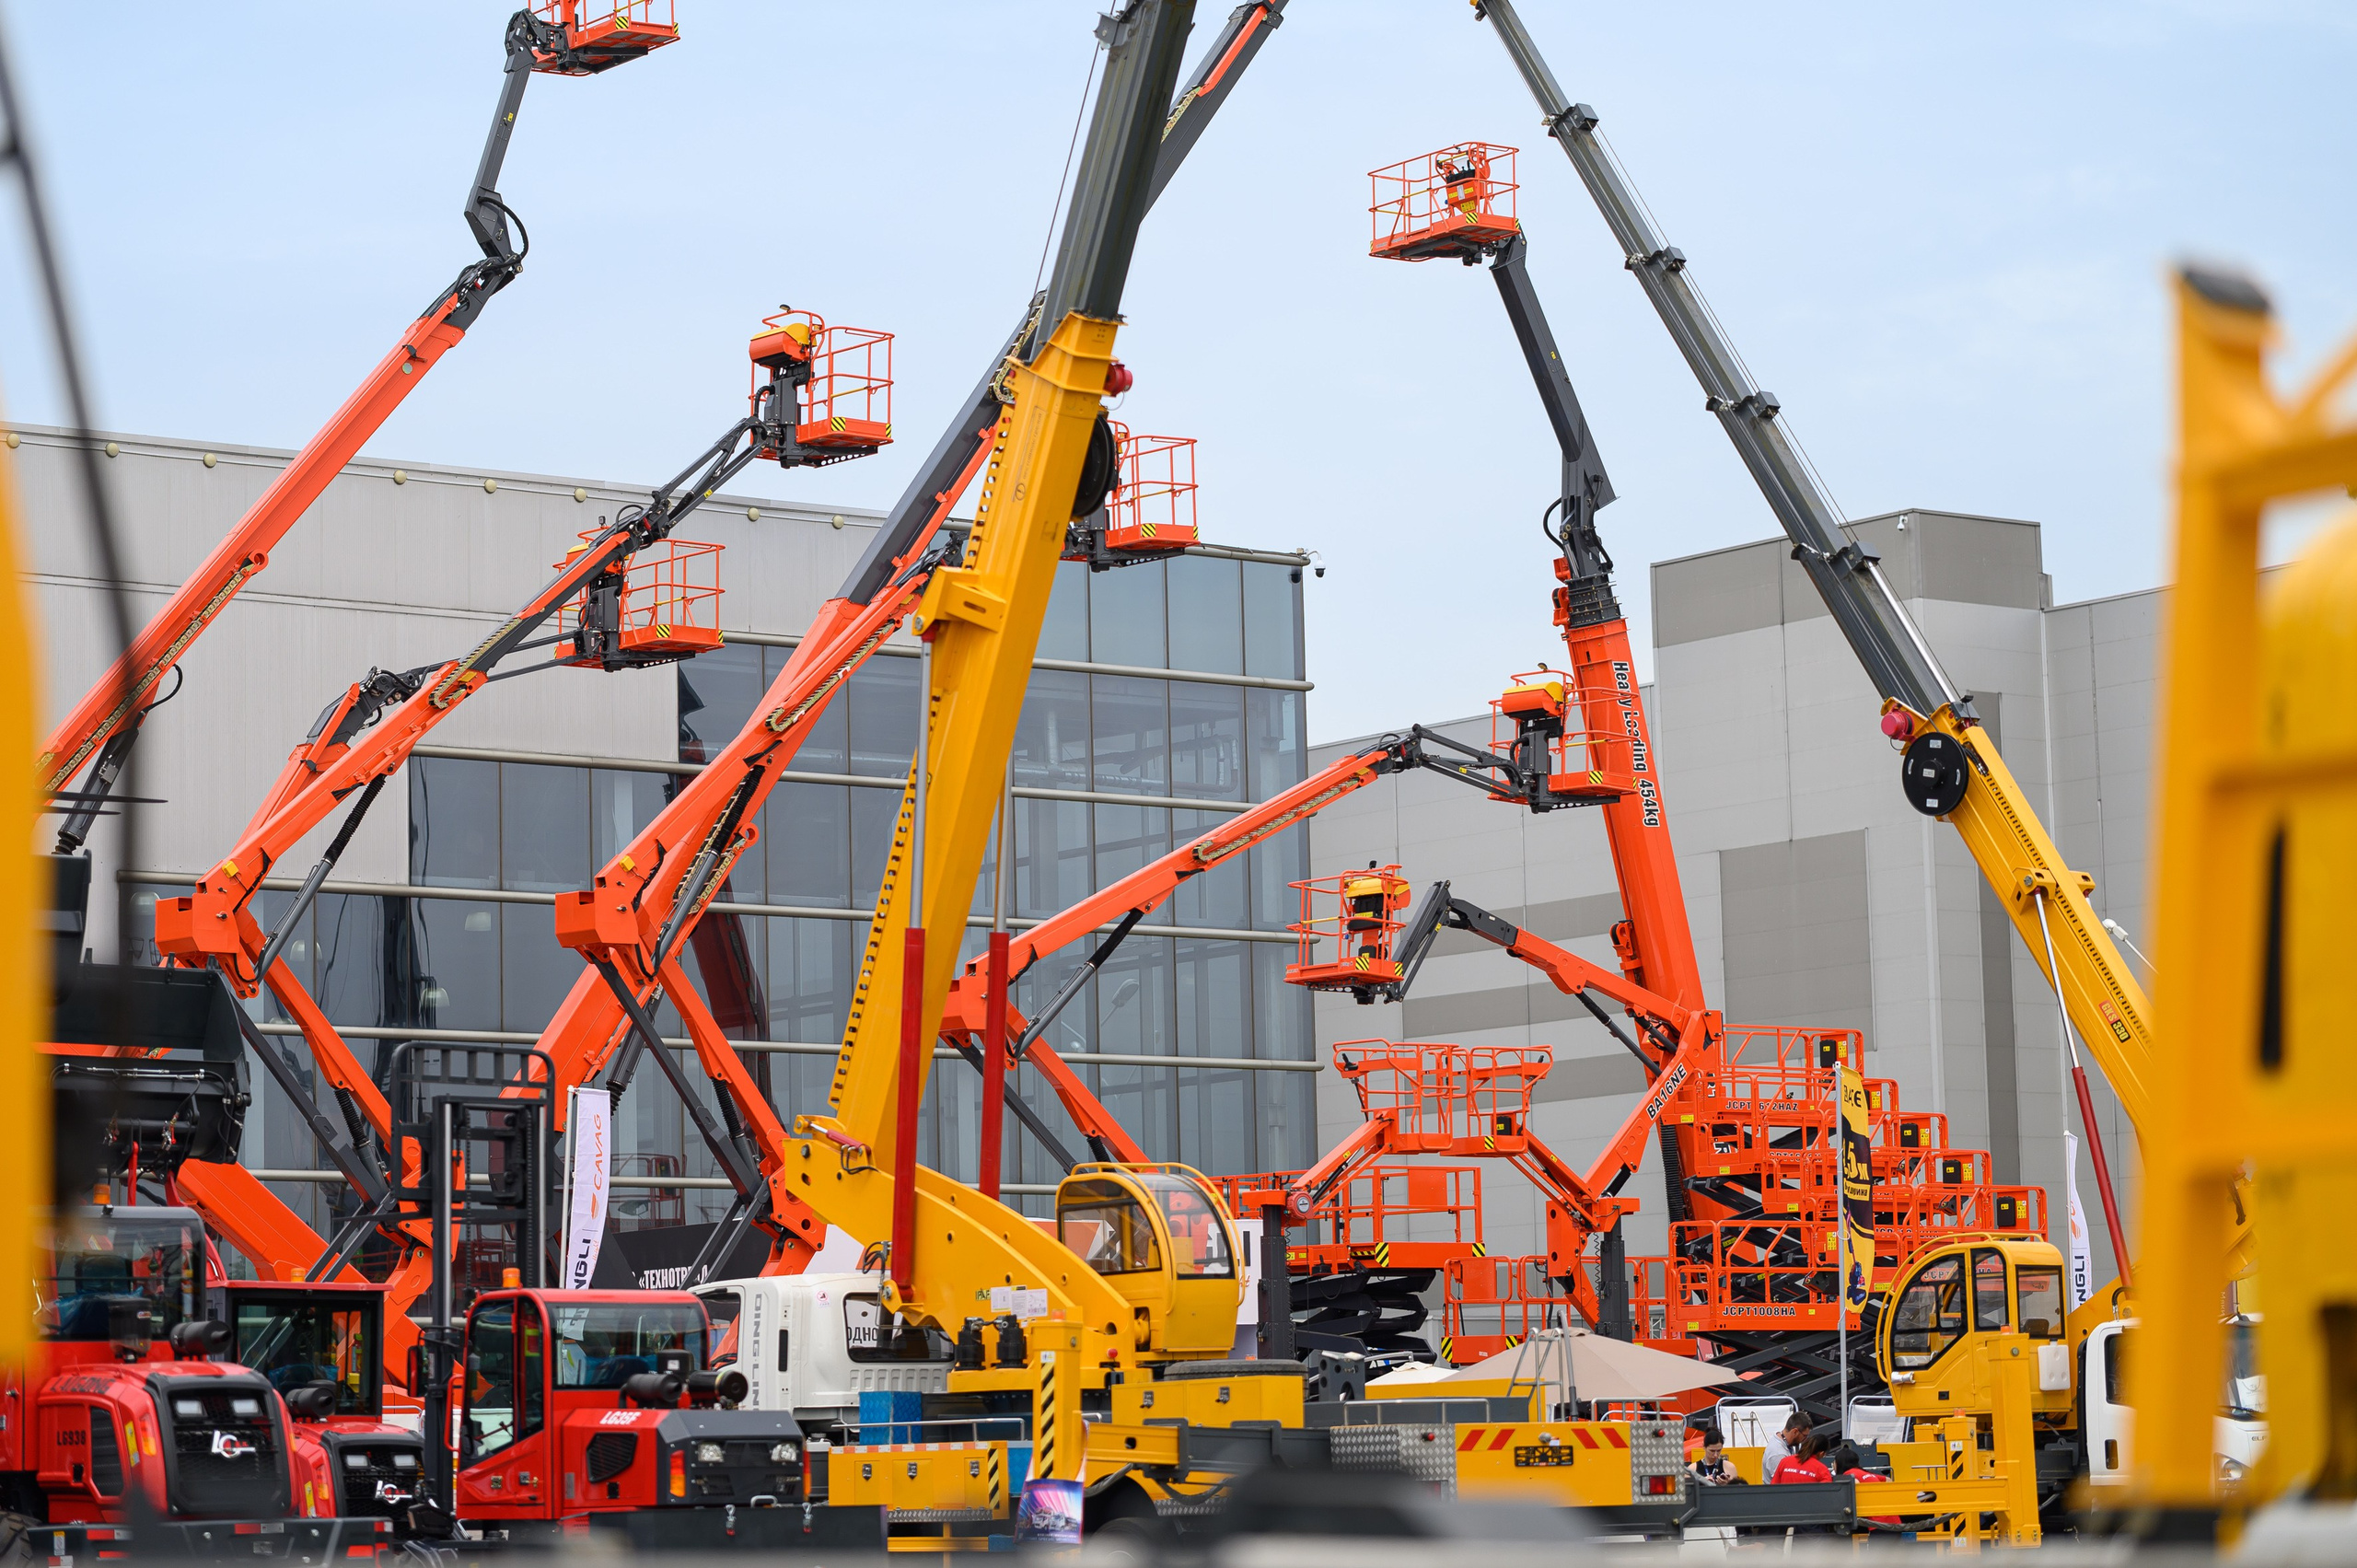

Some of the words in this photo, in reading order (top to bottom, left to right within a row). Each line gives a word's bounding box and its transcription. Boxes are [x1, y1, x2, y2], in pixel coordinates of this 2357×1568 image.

[1611, 661, 1632, 708] Heavy
[1639, 778, 1660, 828] 454kg
[2112, 1021, 2129, 1040] 330
[1646, 1063, 1688, 1121] BA16NE
[1723, 1306, 1796, 1317] JCPT1008HA
[56, 1430, 87, 1446] LG938
